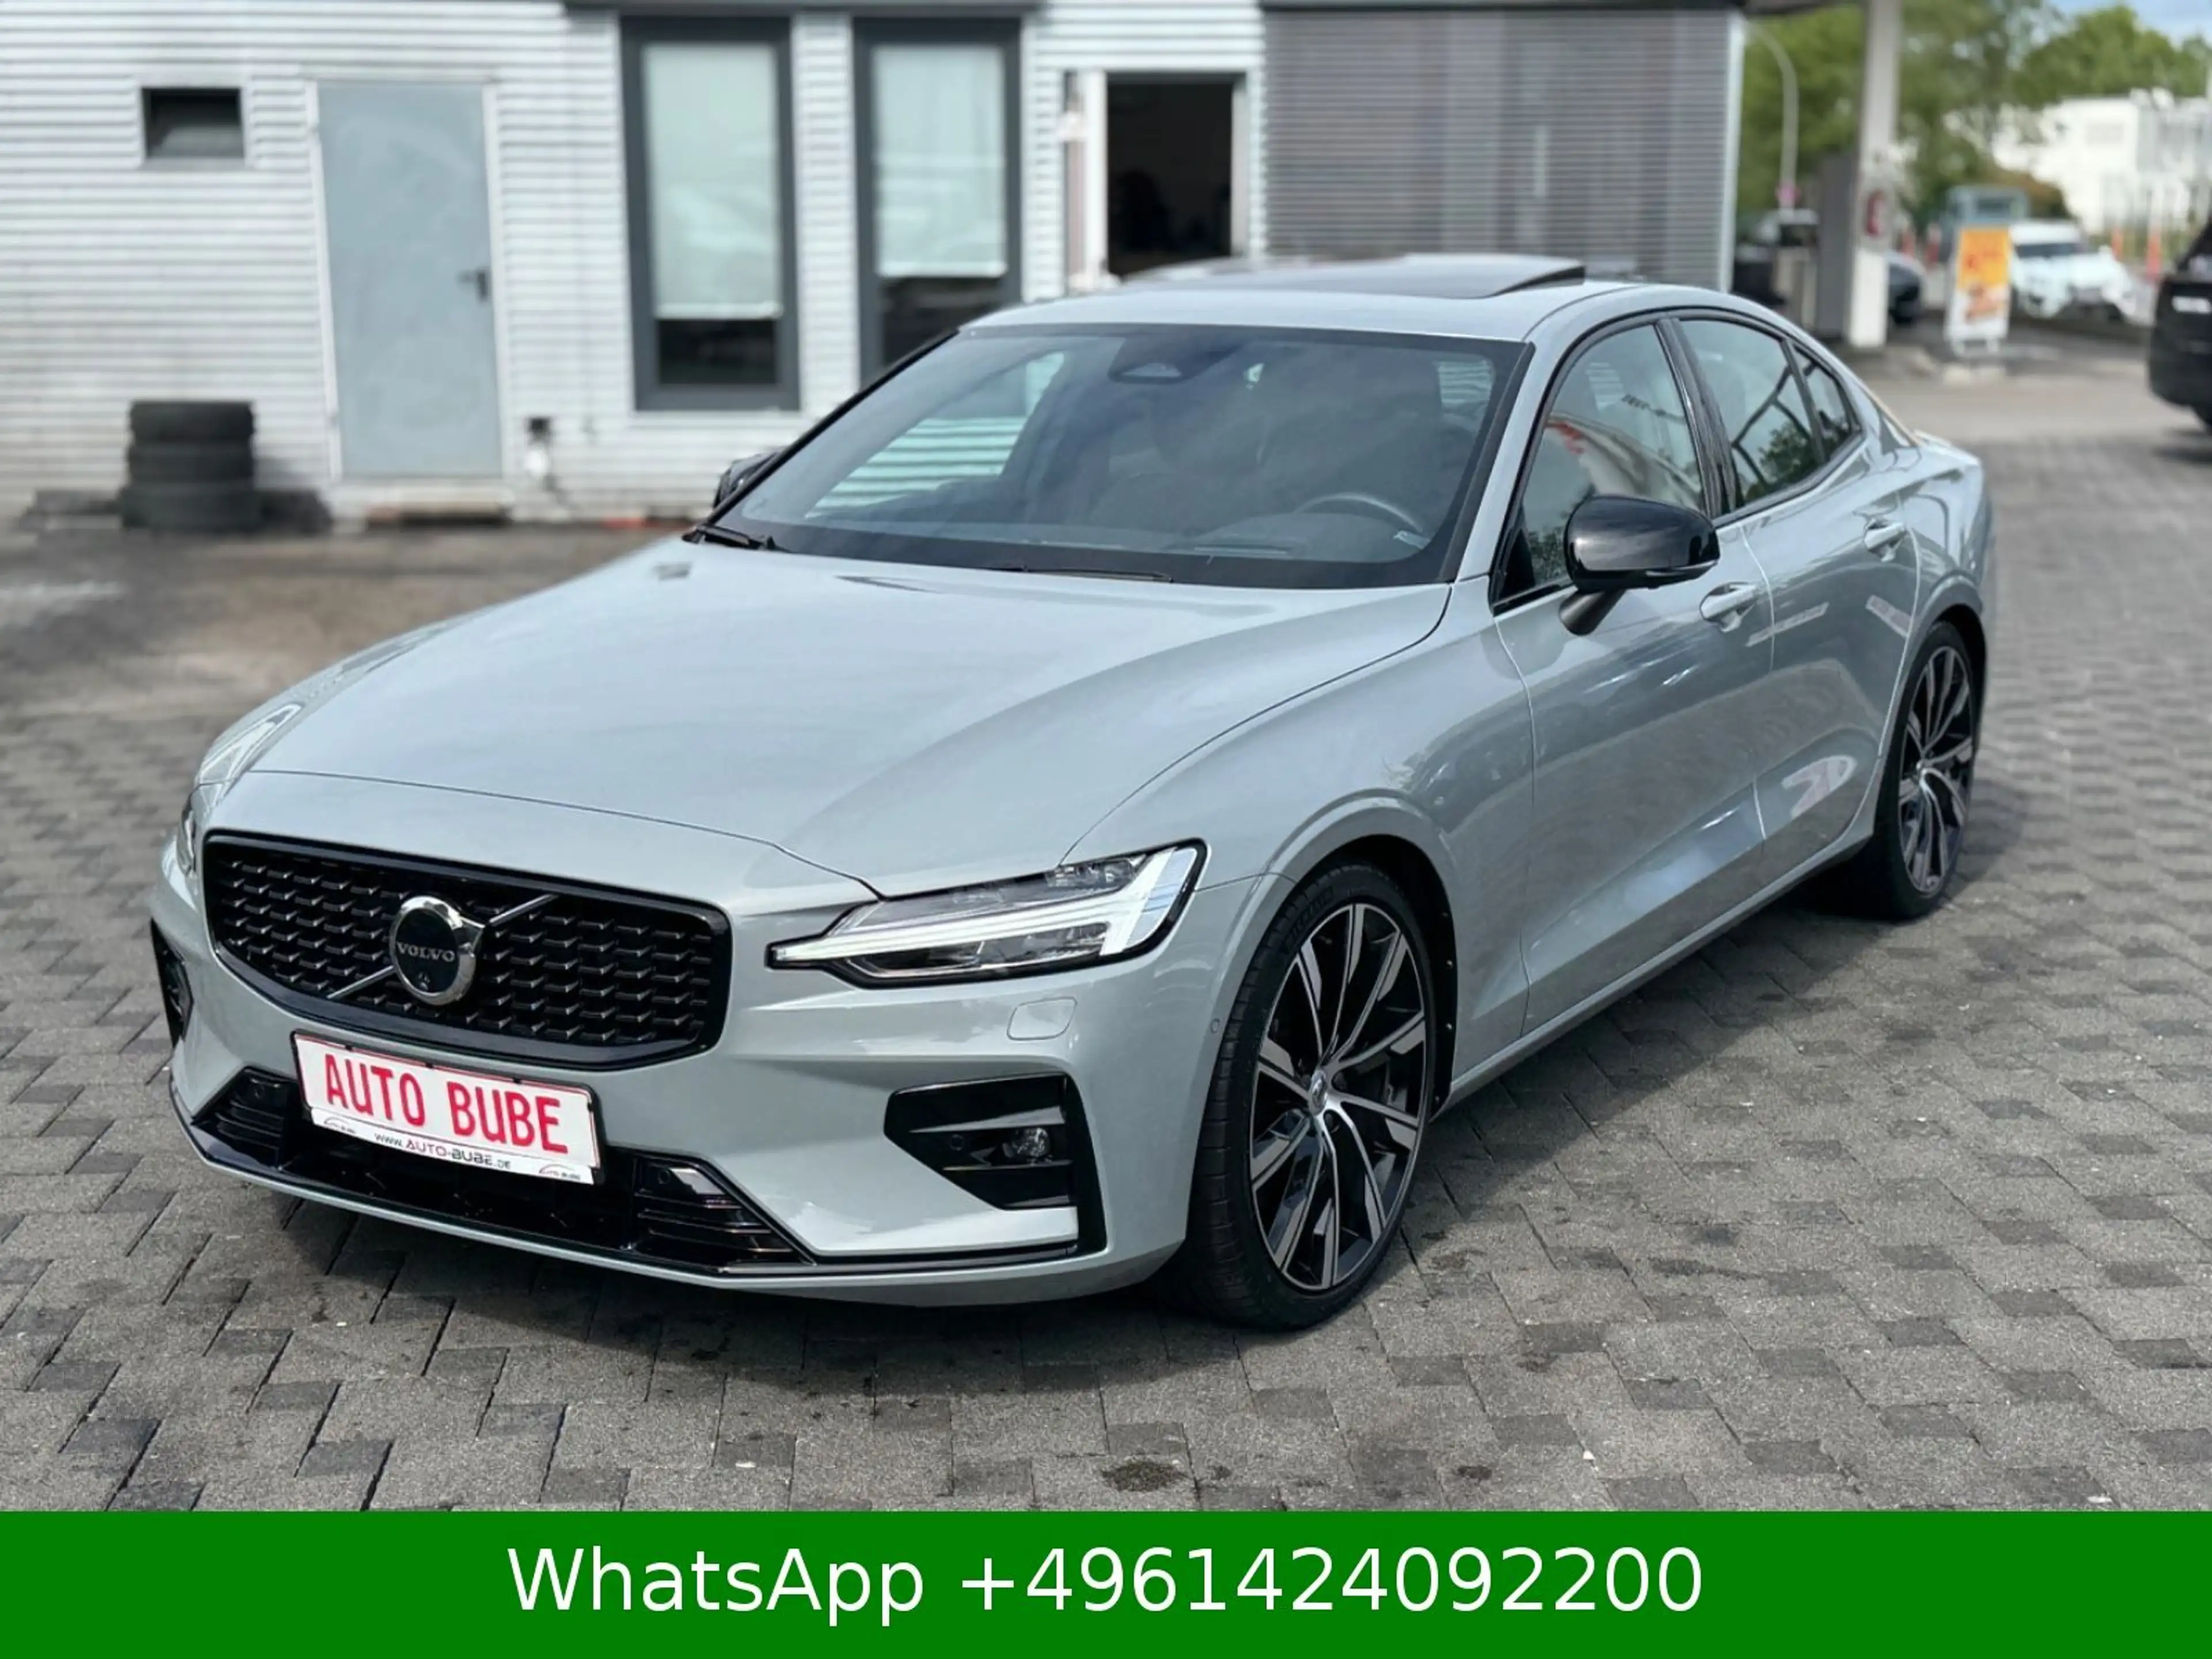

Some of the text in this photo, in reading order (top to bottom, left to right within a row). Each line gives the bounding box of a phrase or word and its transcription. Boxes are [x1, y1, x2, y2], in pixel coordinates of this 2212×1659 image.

[397, 941, 455, 962] VOLVO
[325, 1055, 567, 1154] AUTO BUBE
